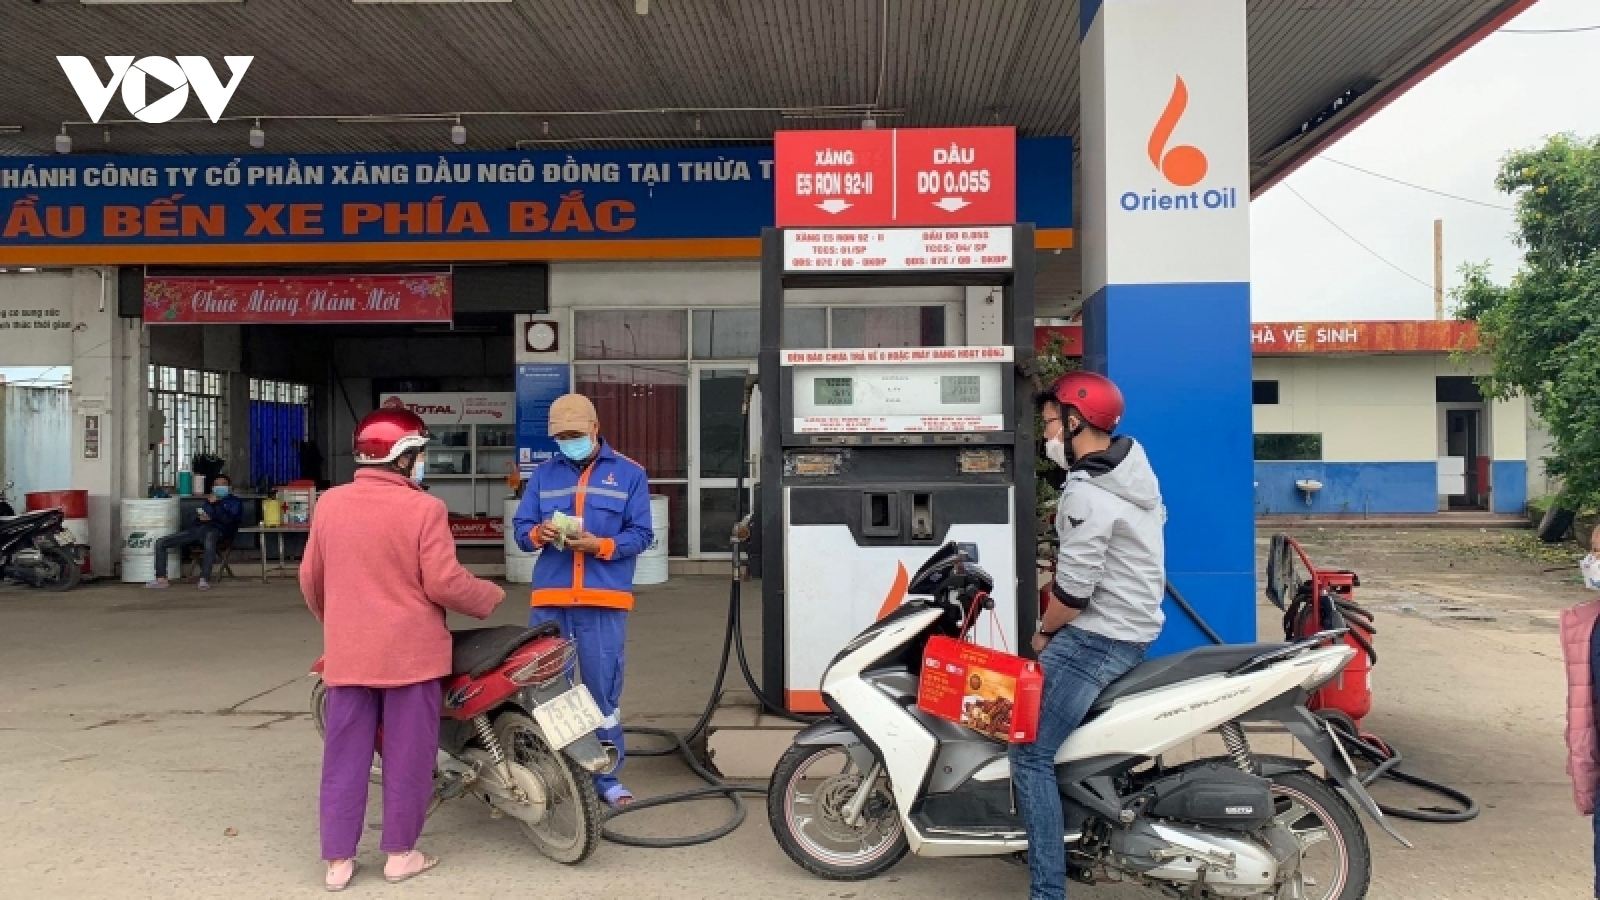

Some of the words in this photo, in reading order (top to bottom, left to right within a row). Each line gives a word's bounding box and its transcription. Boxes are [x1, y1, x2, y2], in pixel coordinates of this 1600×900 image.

[814, 148, 854, 166] XĂNG
[933, 142, 975, 164] DẦU
[0, 164, 77, 187] HÁNH
[83, 163, 157, 187] CÔNG
[165, 167, 198, 187] TY
[205, 158, 242, 187] CỔ
[248, 158, 324, 185] PHẦN
[331, 161, 409, 185] XĂNG
[415, 156, 472, 183] DẦU
[478, 158, 535, 183] NGÔ
[542, 156, 621, 183] ĐỒNG
[628, 163, 671, 187] TẠI
[678, 156, 751, 181] THỪA
[758, 160, 775, 179] T
[796, 172, 813, 195] E5
[815, 172, 841, 195] RON
[917, 170, 940, 194] DO
[943, 169, 990, 193] 0.05S
[1119, 188, 1199, 211] Orient
[1203, 187, 1237, 209] Oil
[2, 194, 86, 238] ẦU
[103, 194, 226, 237] BẾN
[244, 203, 325, 235] XE
[342, 195, 490, 234] PHÍA
[509, 189, 638, 233] BẮC
[191, 290, 238, 312] Chúc
[242, 289, 300, 316] Mừng
[305, 289, 357, 311] Năm
[361, 288, 401, 311] Mới
[1251, 327, 1276, 343] HÀ
[1283, 327, 1307, 347] VỆ
[1315, 328, 1359, 344] SINH
